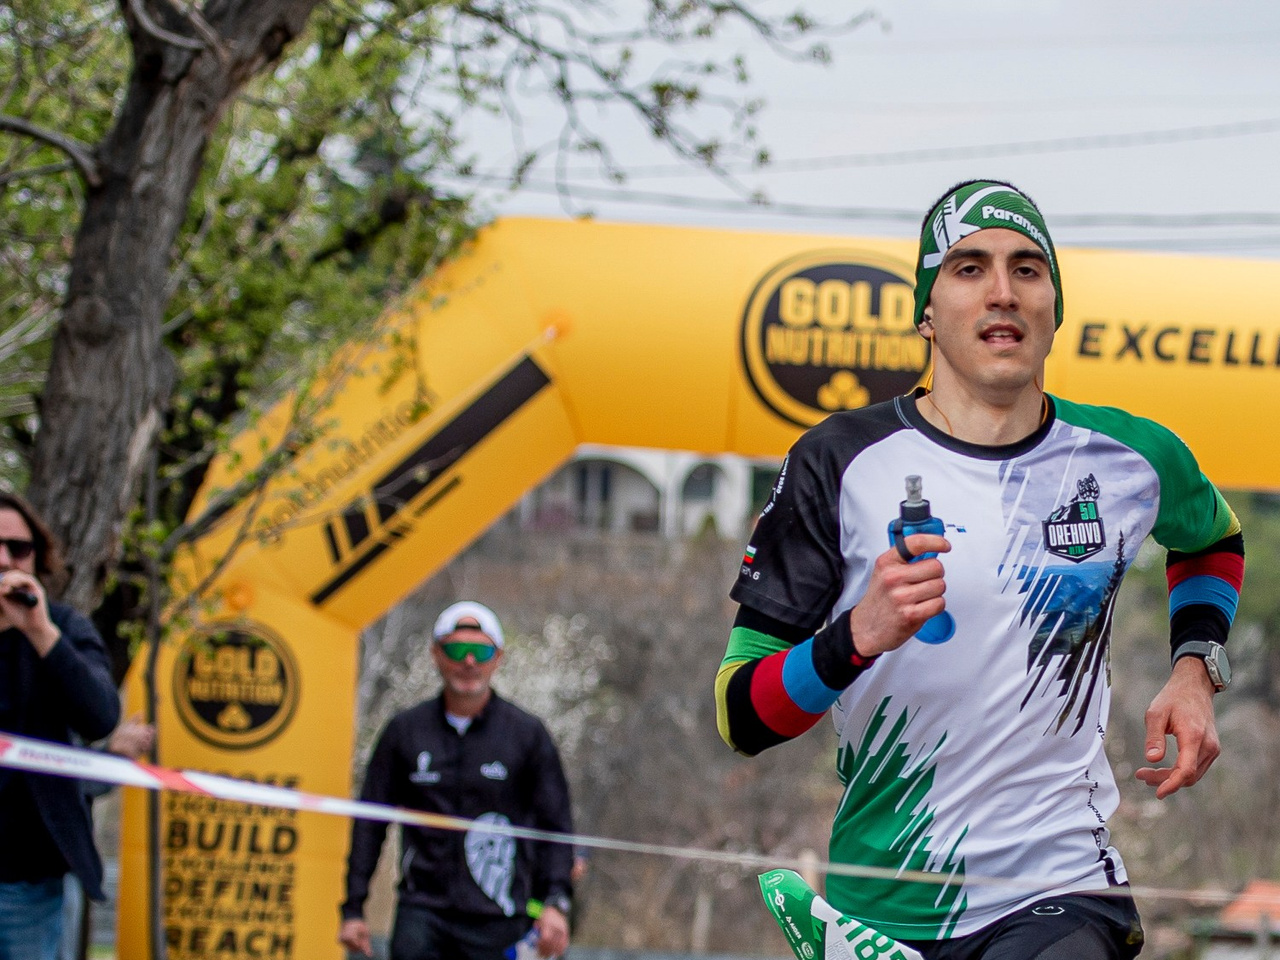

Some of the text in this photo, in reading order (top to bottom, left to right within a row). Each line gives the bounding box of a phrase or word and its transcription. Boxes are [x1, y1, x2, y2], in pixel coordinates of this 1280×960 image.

[779, 276, 914, 332] GOLD
[766, 323, 927, 373] NUTRITION
[1079, 502, 1097, 520] 50
[1048, 521, 1102, 546] OREHOVO
[167, 820, 299, 856] BUILD
[164, 877, 294, 904] DEFINE
[166, 927, 294, 956] REACH
